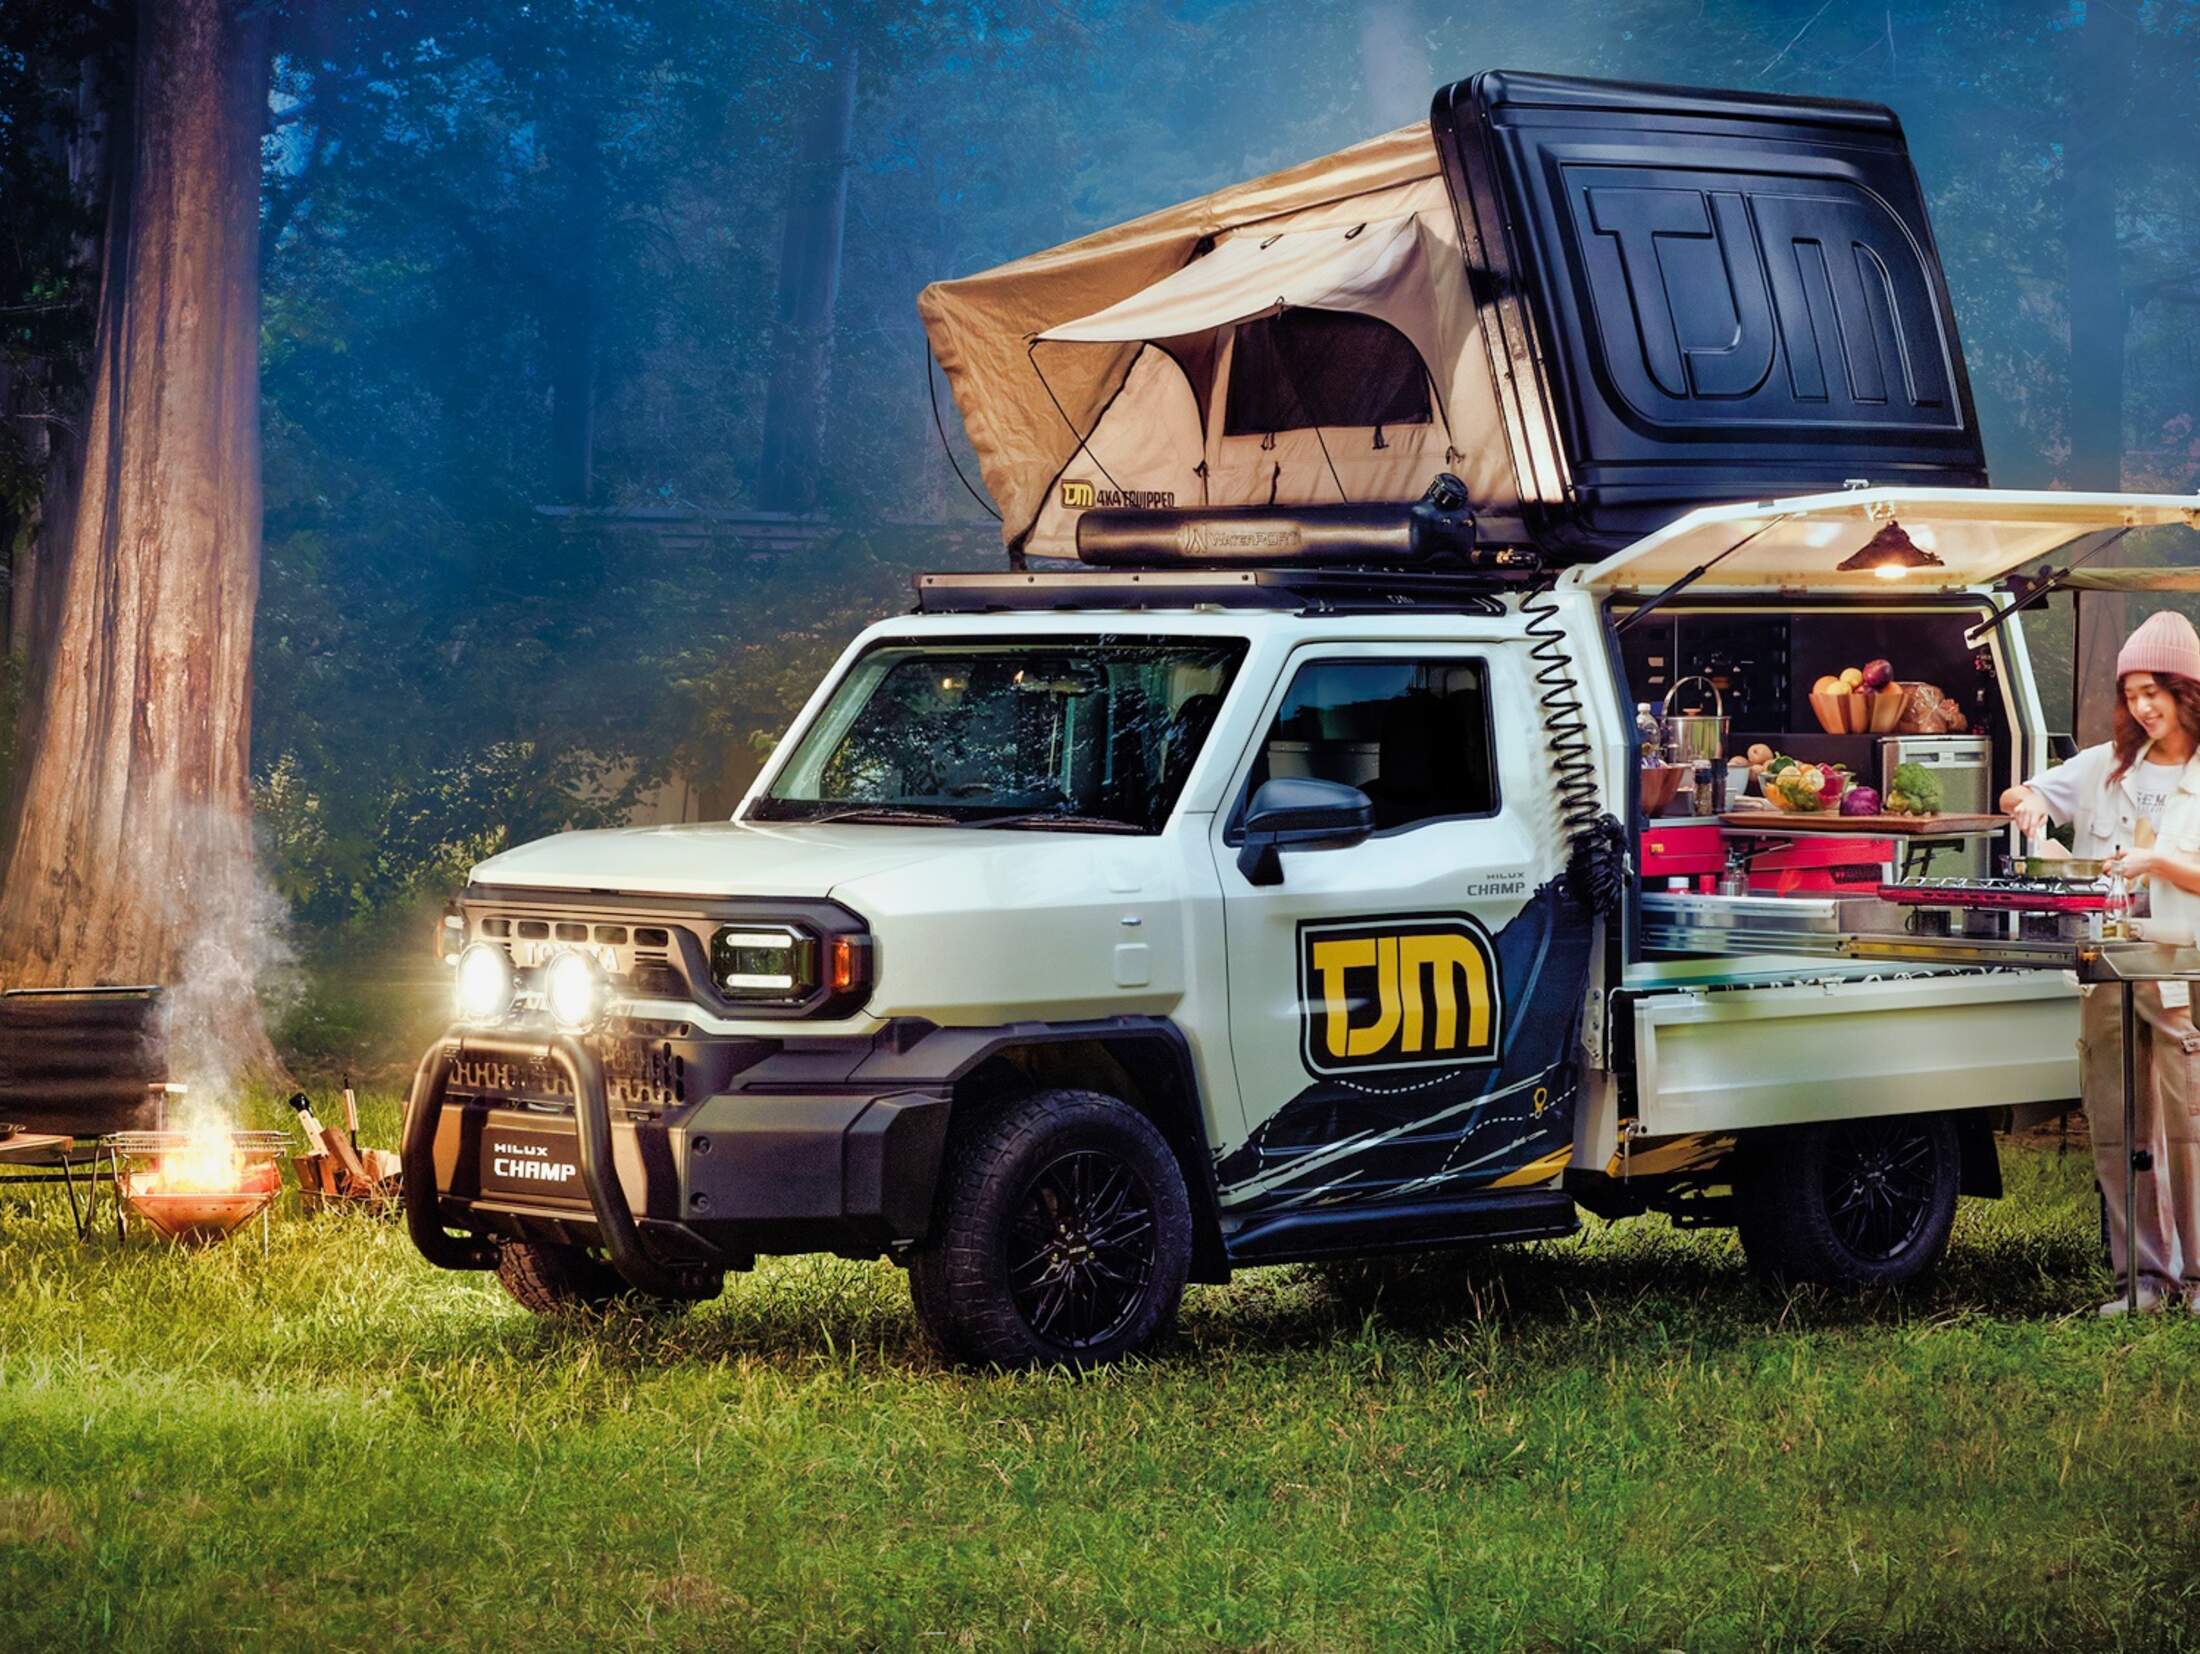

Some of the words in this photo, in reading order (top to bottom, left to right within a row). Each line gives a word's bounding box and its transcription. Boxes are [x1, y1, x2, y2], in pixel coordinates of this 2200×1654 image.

[1581, 184, 1943, 407] TJM
[1062, 482, 1094, 507] TJM
[1123, 490, 1175, 508] EQUIPPED
[1487, 872, 1525, 880] HILUX
[1467, 882, 1526, 896] CHAMP
[1313, 934, 1490, 1058] TJM
[494, 1143, 549, 1157] HILUX
[494, 1158, 576, 1182] CHAMP
